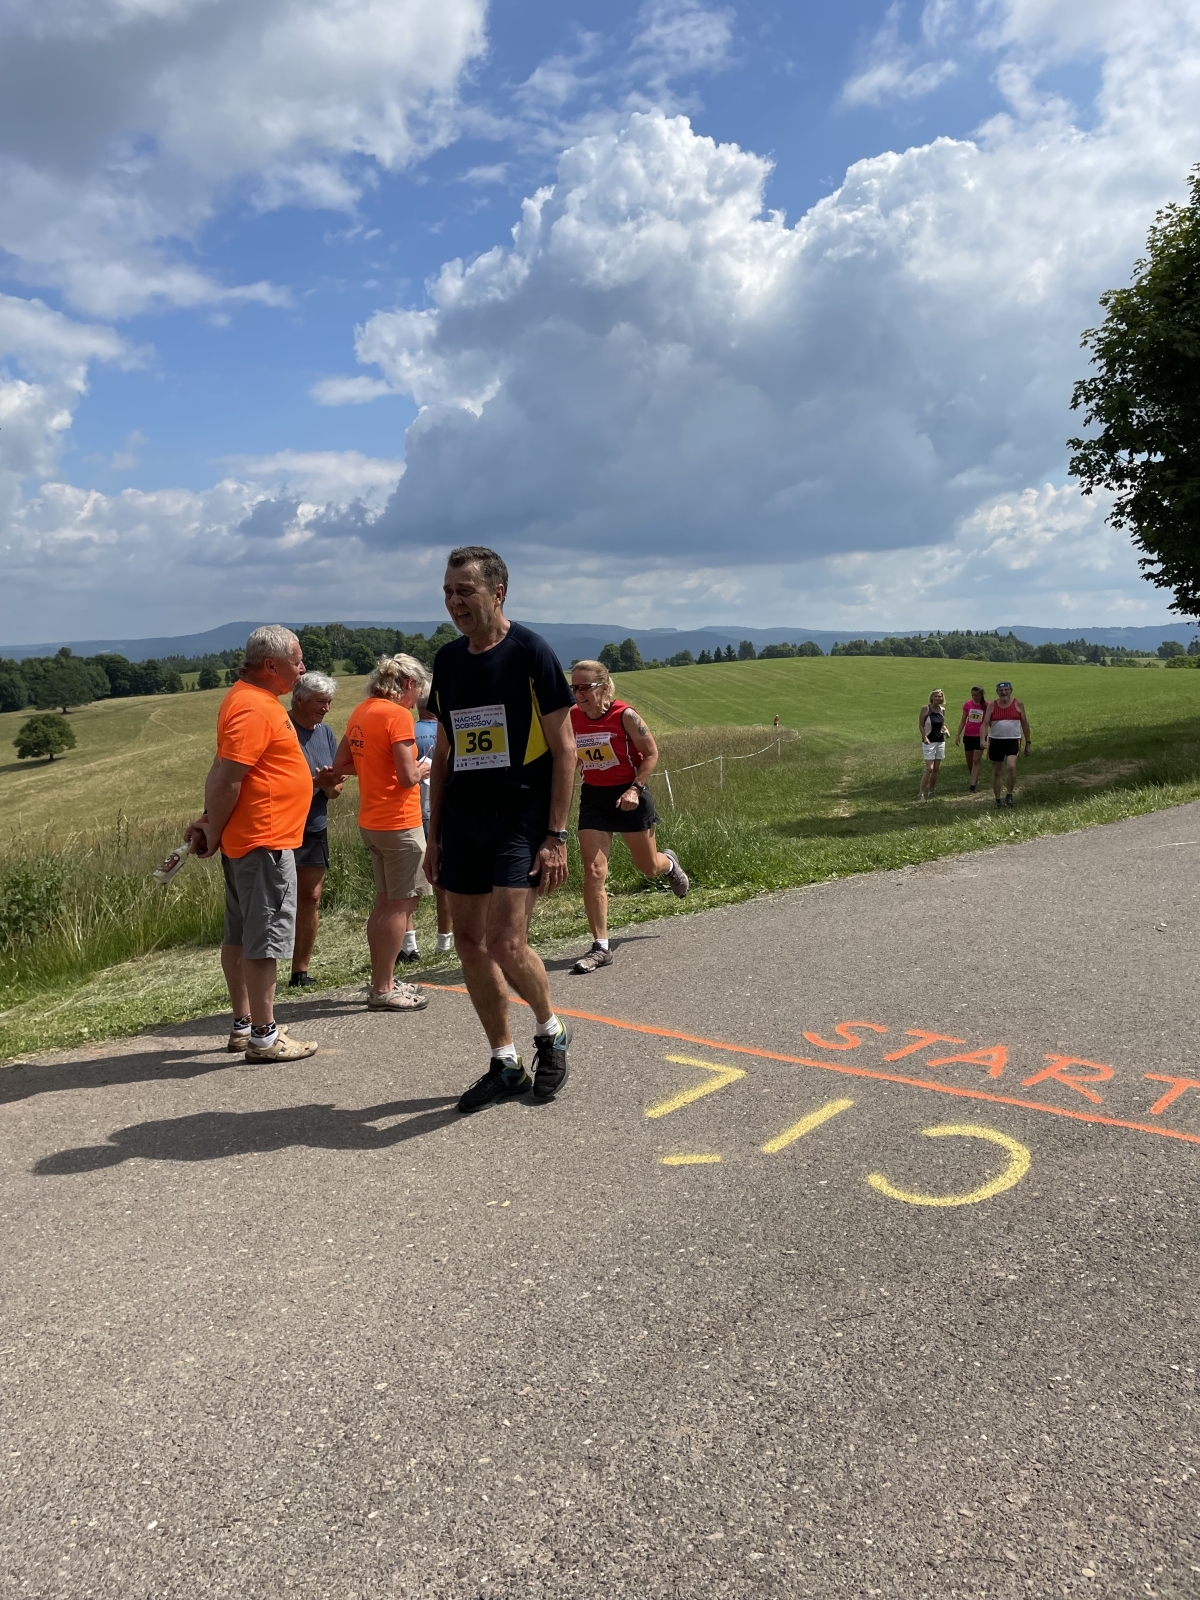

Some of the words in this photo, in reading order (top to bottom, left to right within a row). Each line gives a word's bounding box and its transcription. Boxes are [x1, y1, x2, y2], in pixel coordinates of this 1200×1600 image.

[454, 714, 481, 723] NÁCHOD
[466, 730, 493, 753] 36
[585, 748, 604, 761] 14
[803, 1021, 1200, 1115] START
